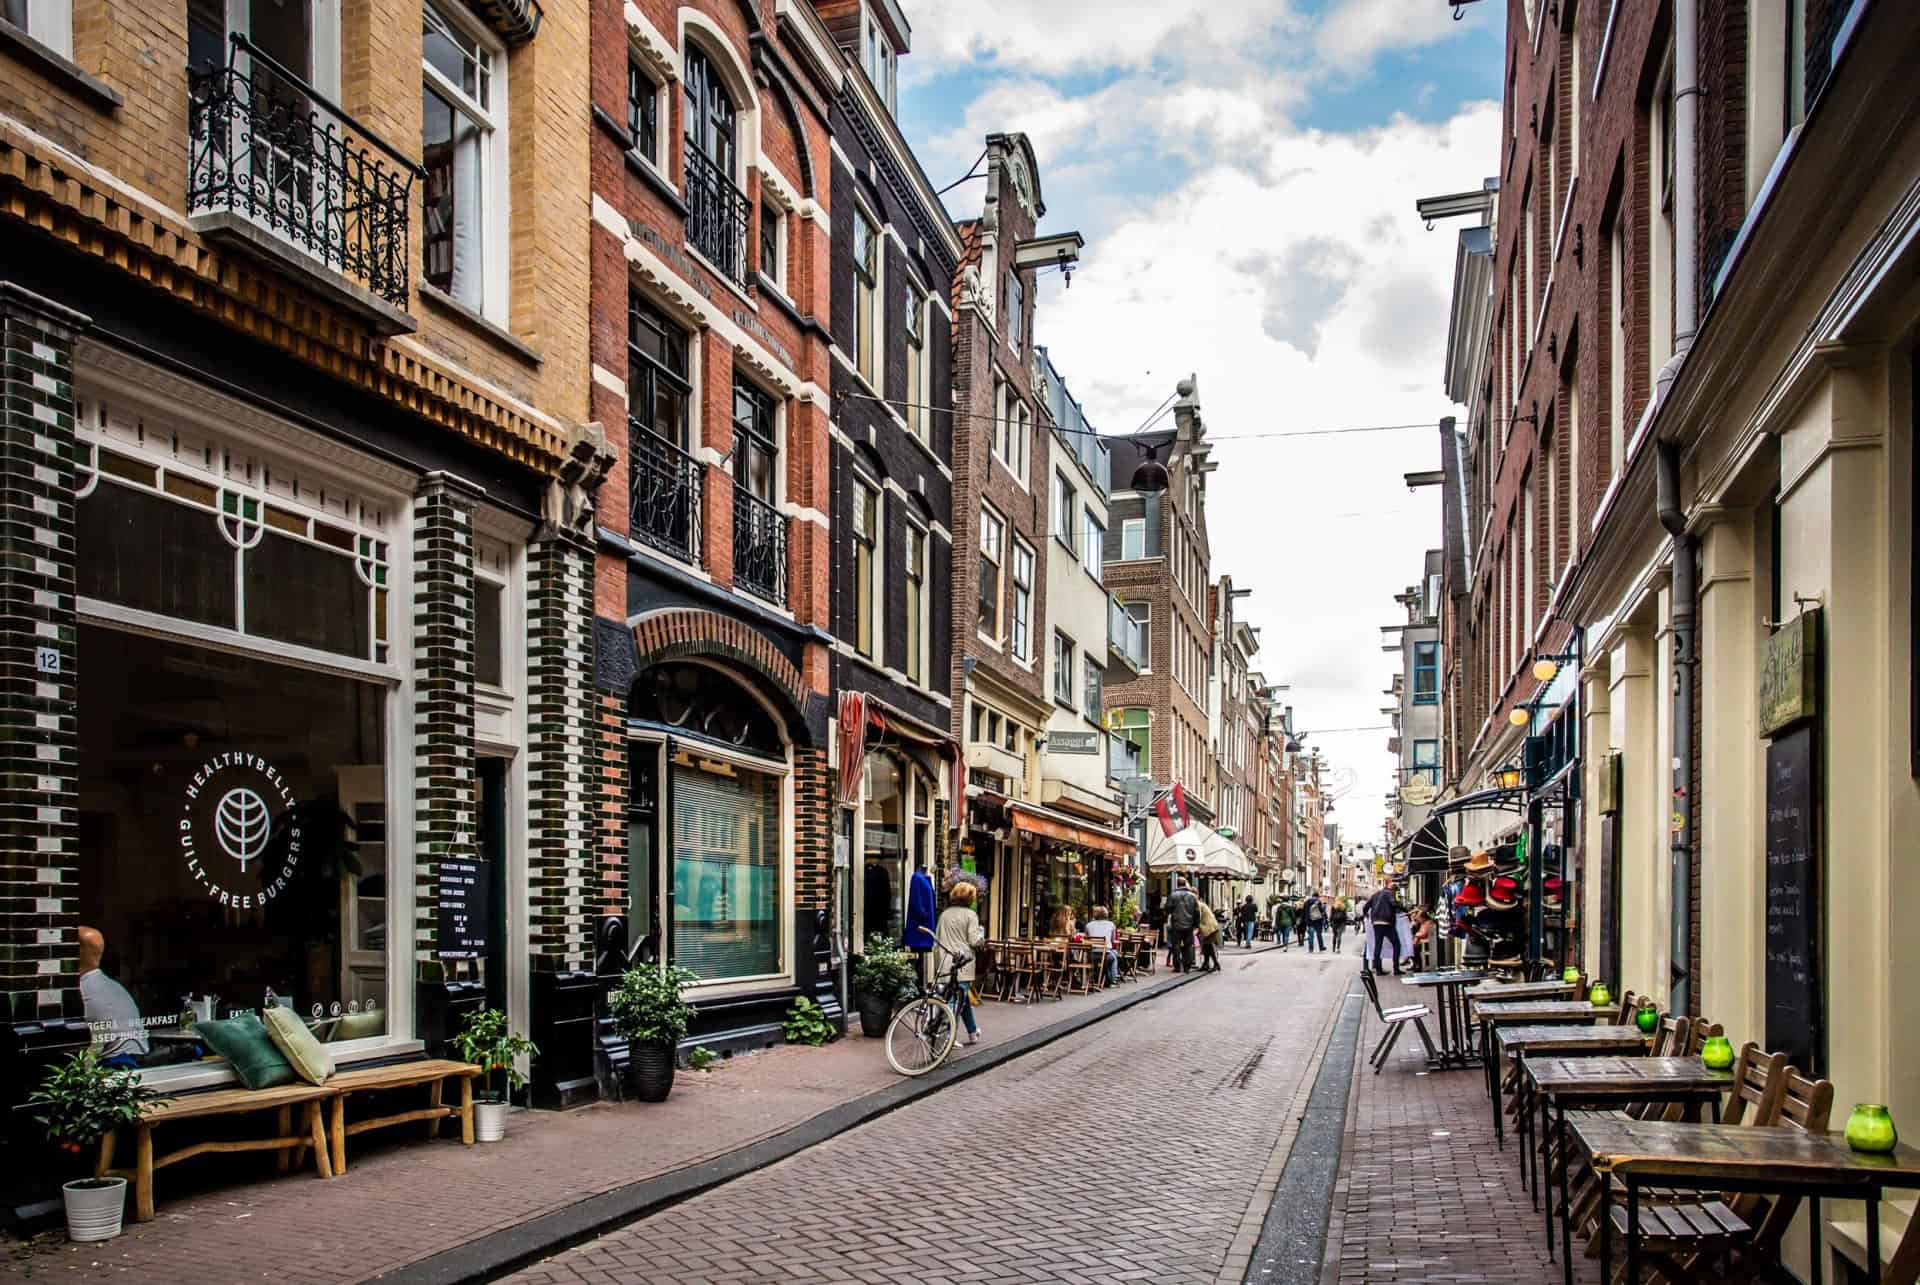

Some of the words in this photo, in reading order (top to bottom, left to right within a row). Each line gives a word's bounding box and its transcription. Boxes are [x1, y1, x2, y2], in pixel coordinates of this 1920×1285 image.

[40, 652, 57, 669] 12
[186, 751, 296, 811] HEALTHYBELLY
[180, 819, 251, 909] GUILT-FREE
[257, 827, 301, 905] BURGERS
